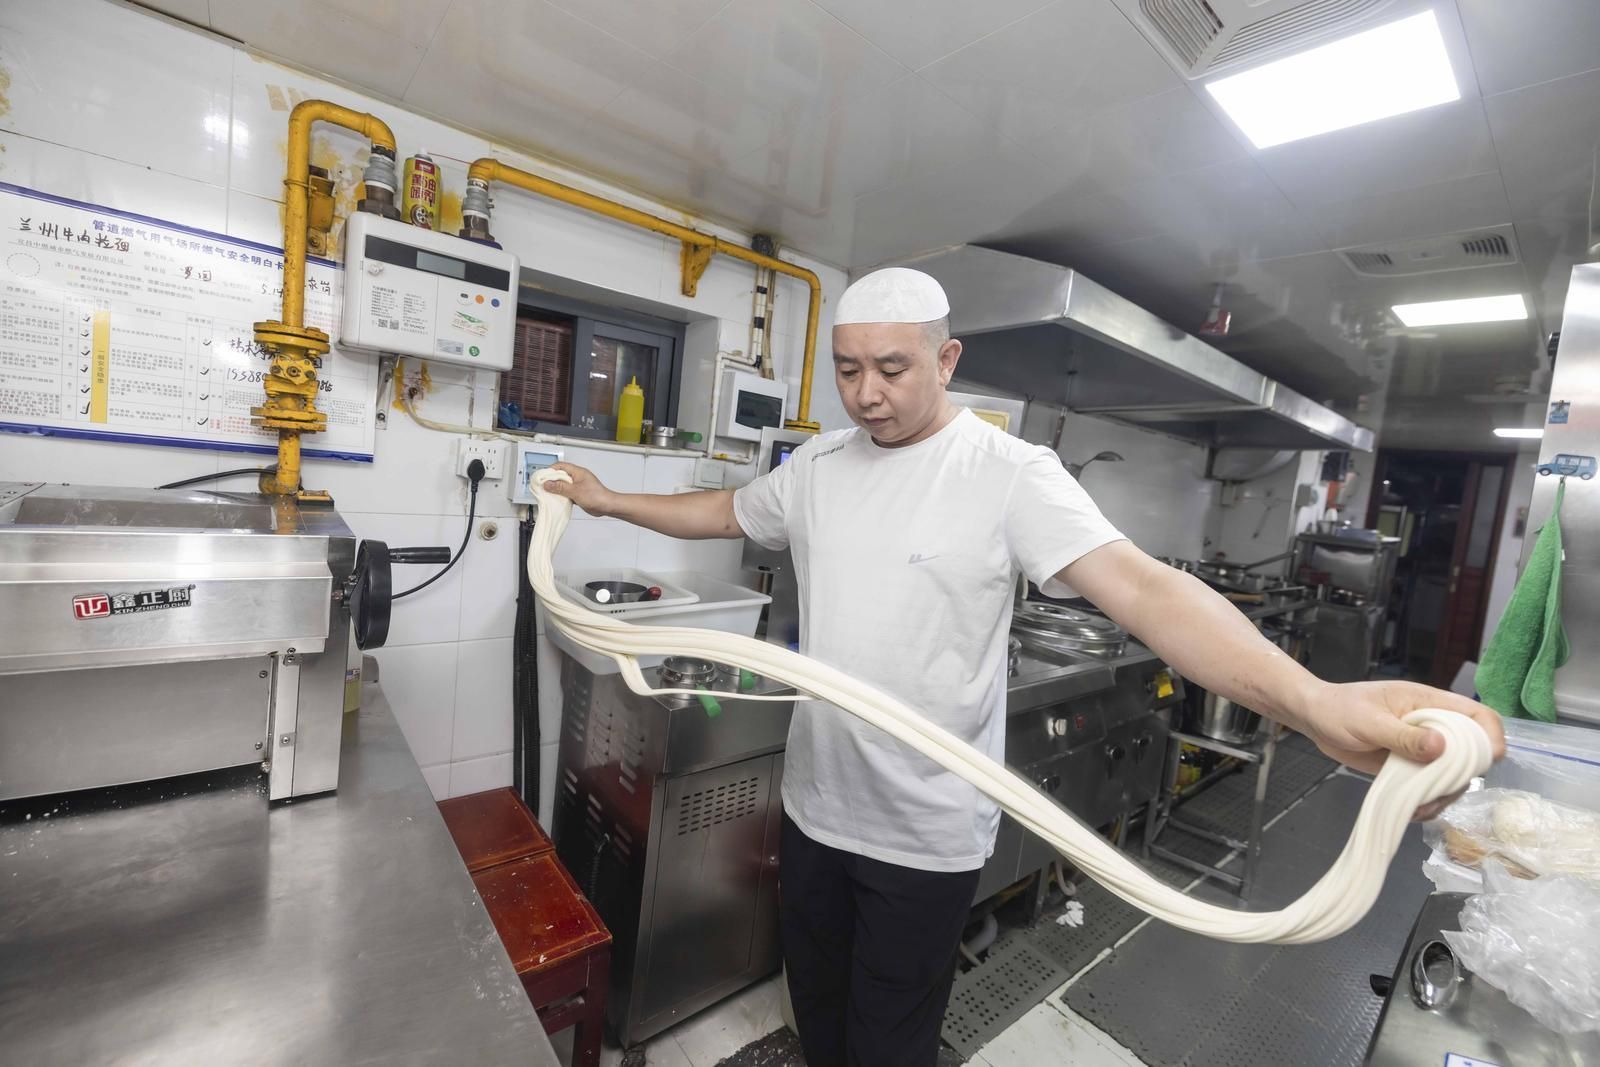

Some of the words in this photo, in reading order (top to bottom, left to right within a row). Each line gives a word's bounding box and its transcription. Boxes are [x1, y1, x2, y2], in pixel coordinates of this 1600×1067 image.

[92, 219, 284, 270] 管道燃气用气场所燃气安全明白卡
[112, 586, 191, 609] 鑫正厨
